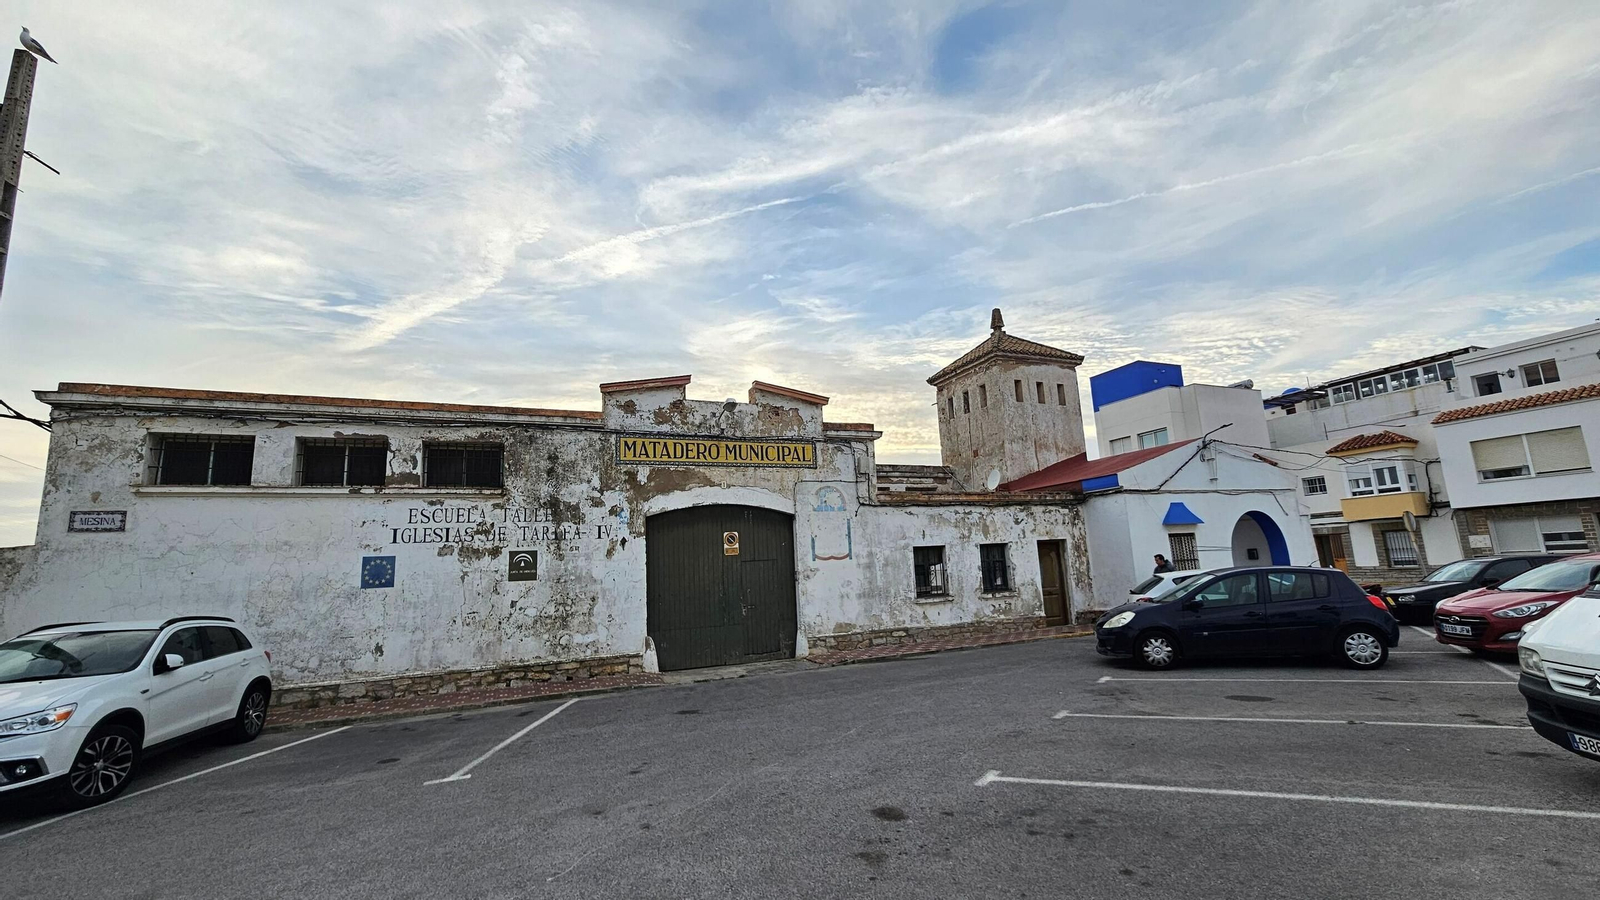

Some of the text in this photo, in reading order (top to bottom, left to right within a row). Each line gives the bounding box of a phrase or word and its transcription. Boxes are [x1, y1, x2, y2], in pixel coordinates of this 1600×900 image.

[623, 440, 812, 463] MATADERO MUNICIPAL
[79, 517, 116, 526] MESINA
[408, 507, 556, 524] ESCUELA TALLE
[389, 527, 475, 544] IGLESIAS
